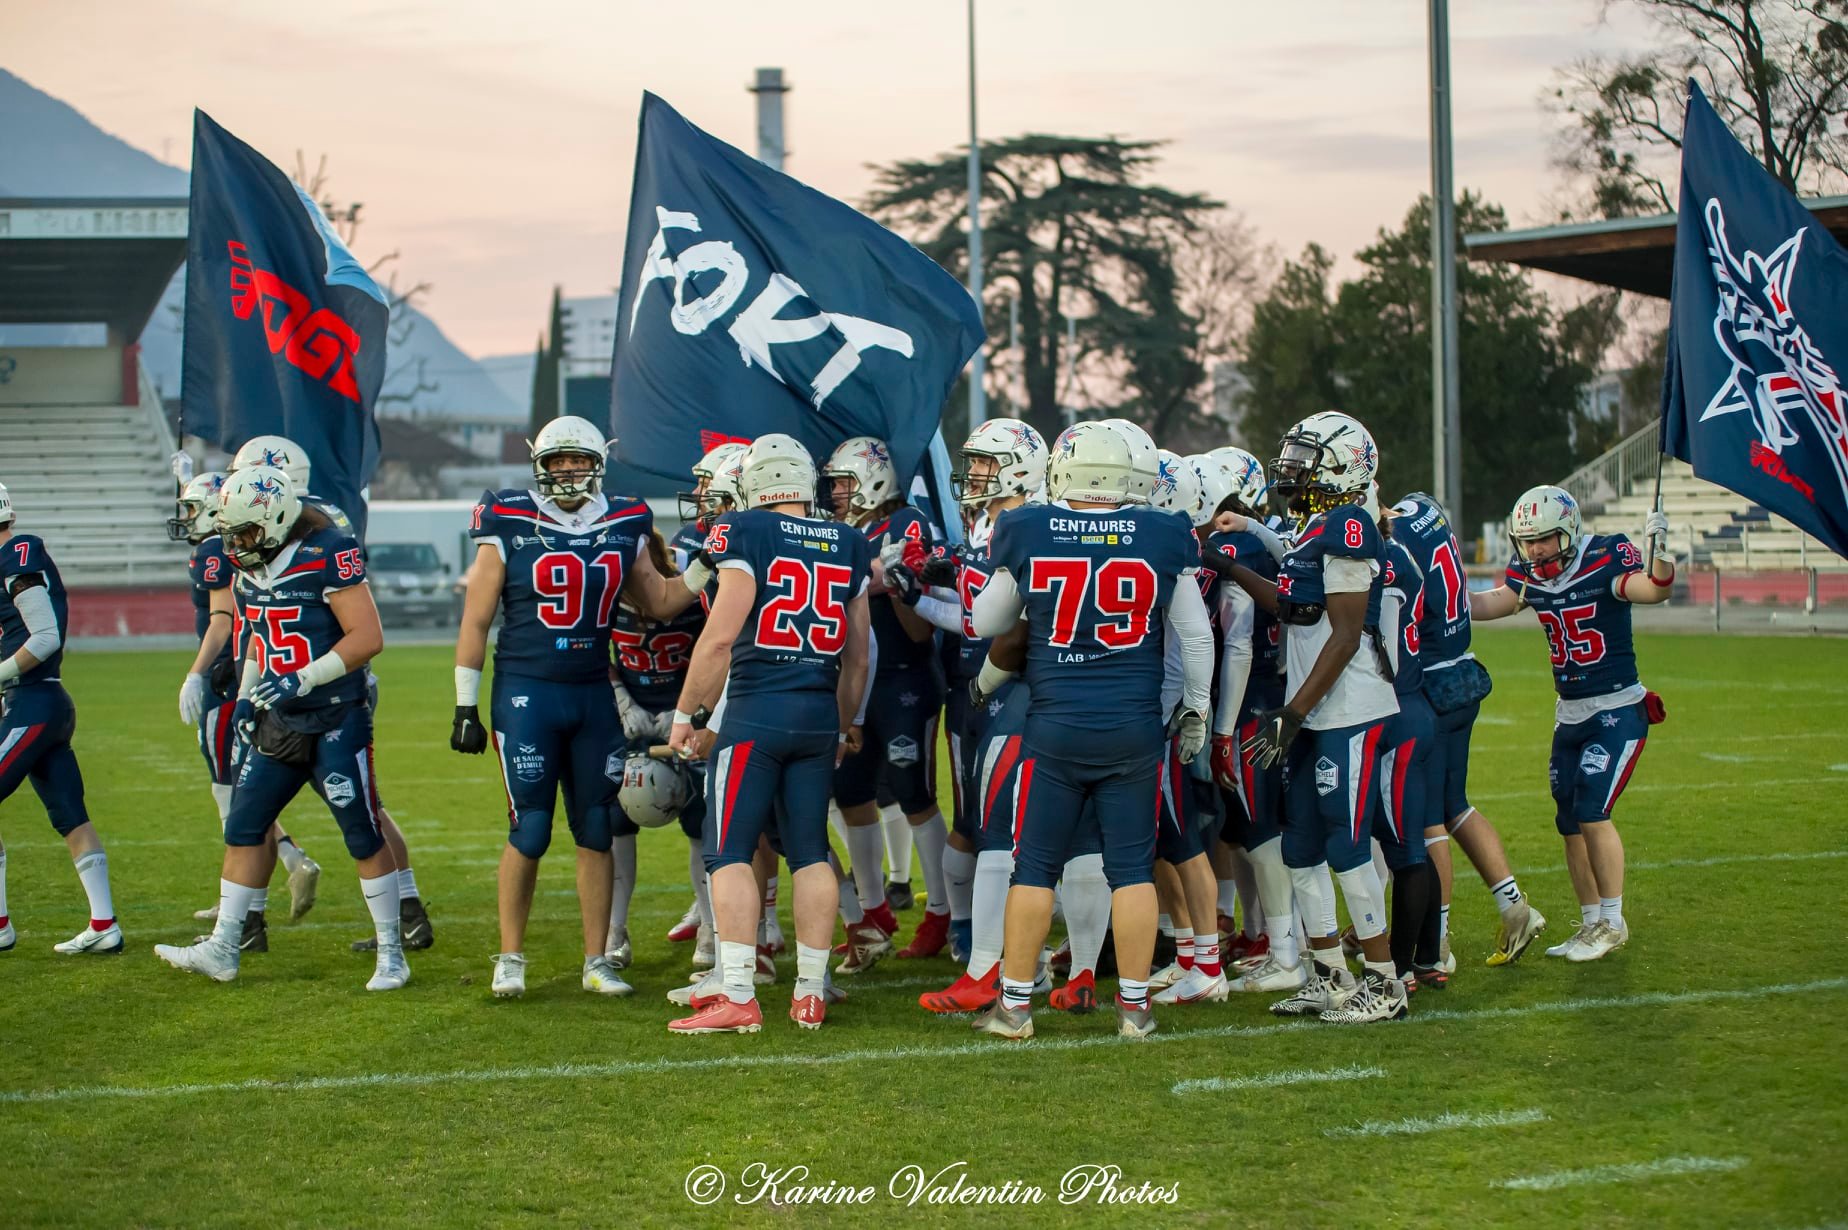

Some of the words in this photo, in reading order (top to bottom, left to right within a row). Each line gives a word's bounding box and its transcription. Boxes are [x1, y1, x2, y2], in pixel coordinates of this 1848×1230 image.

[760, 492, 800, 503] Riddell
[780, 521, 839, 540] CENTAURES
[905, 520, 921, 541] 4
[1049, 517, 1137, 533] CENTAURES
[1344, 518, 1363, 549] 8
[14, 542, 29, 566] 7
[335, 548, 364, 580] 55
[1616, 542, 1642, 566] 35
[204, 556, 220, 582] 2
[533, 551, 623, 629] 91
[1029, 557, 1157, 649] 79
[755, 556, 852, 655] 25
[246, 605, 312, 678] 55
[1536, 602, 1606, 667] 35
[1058, 652, 1085, 663] LAB
